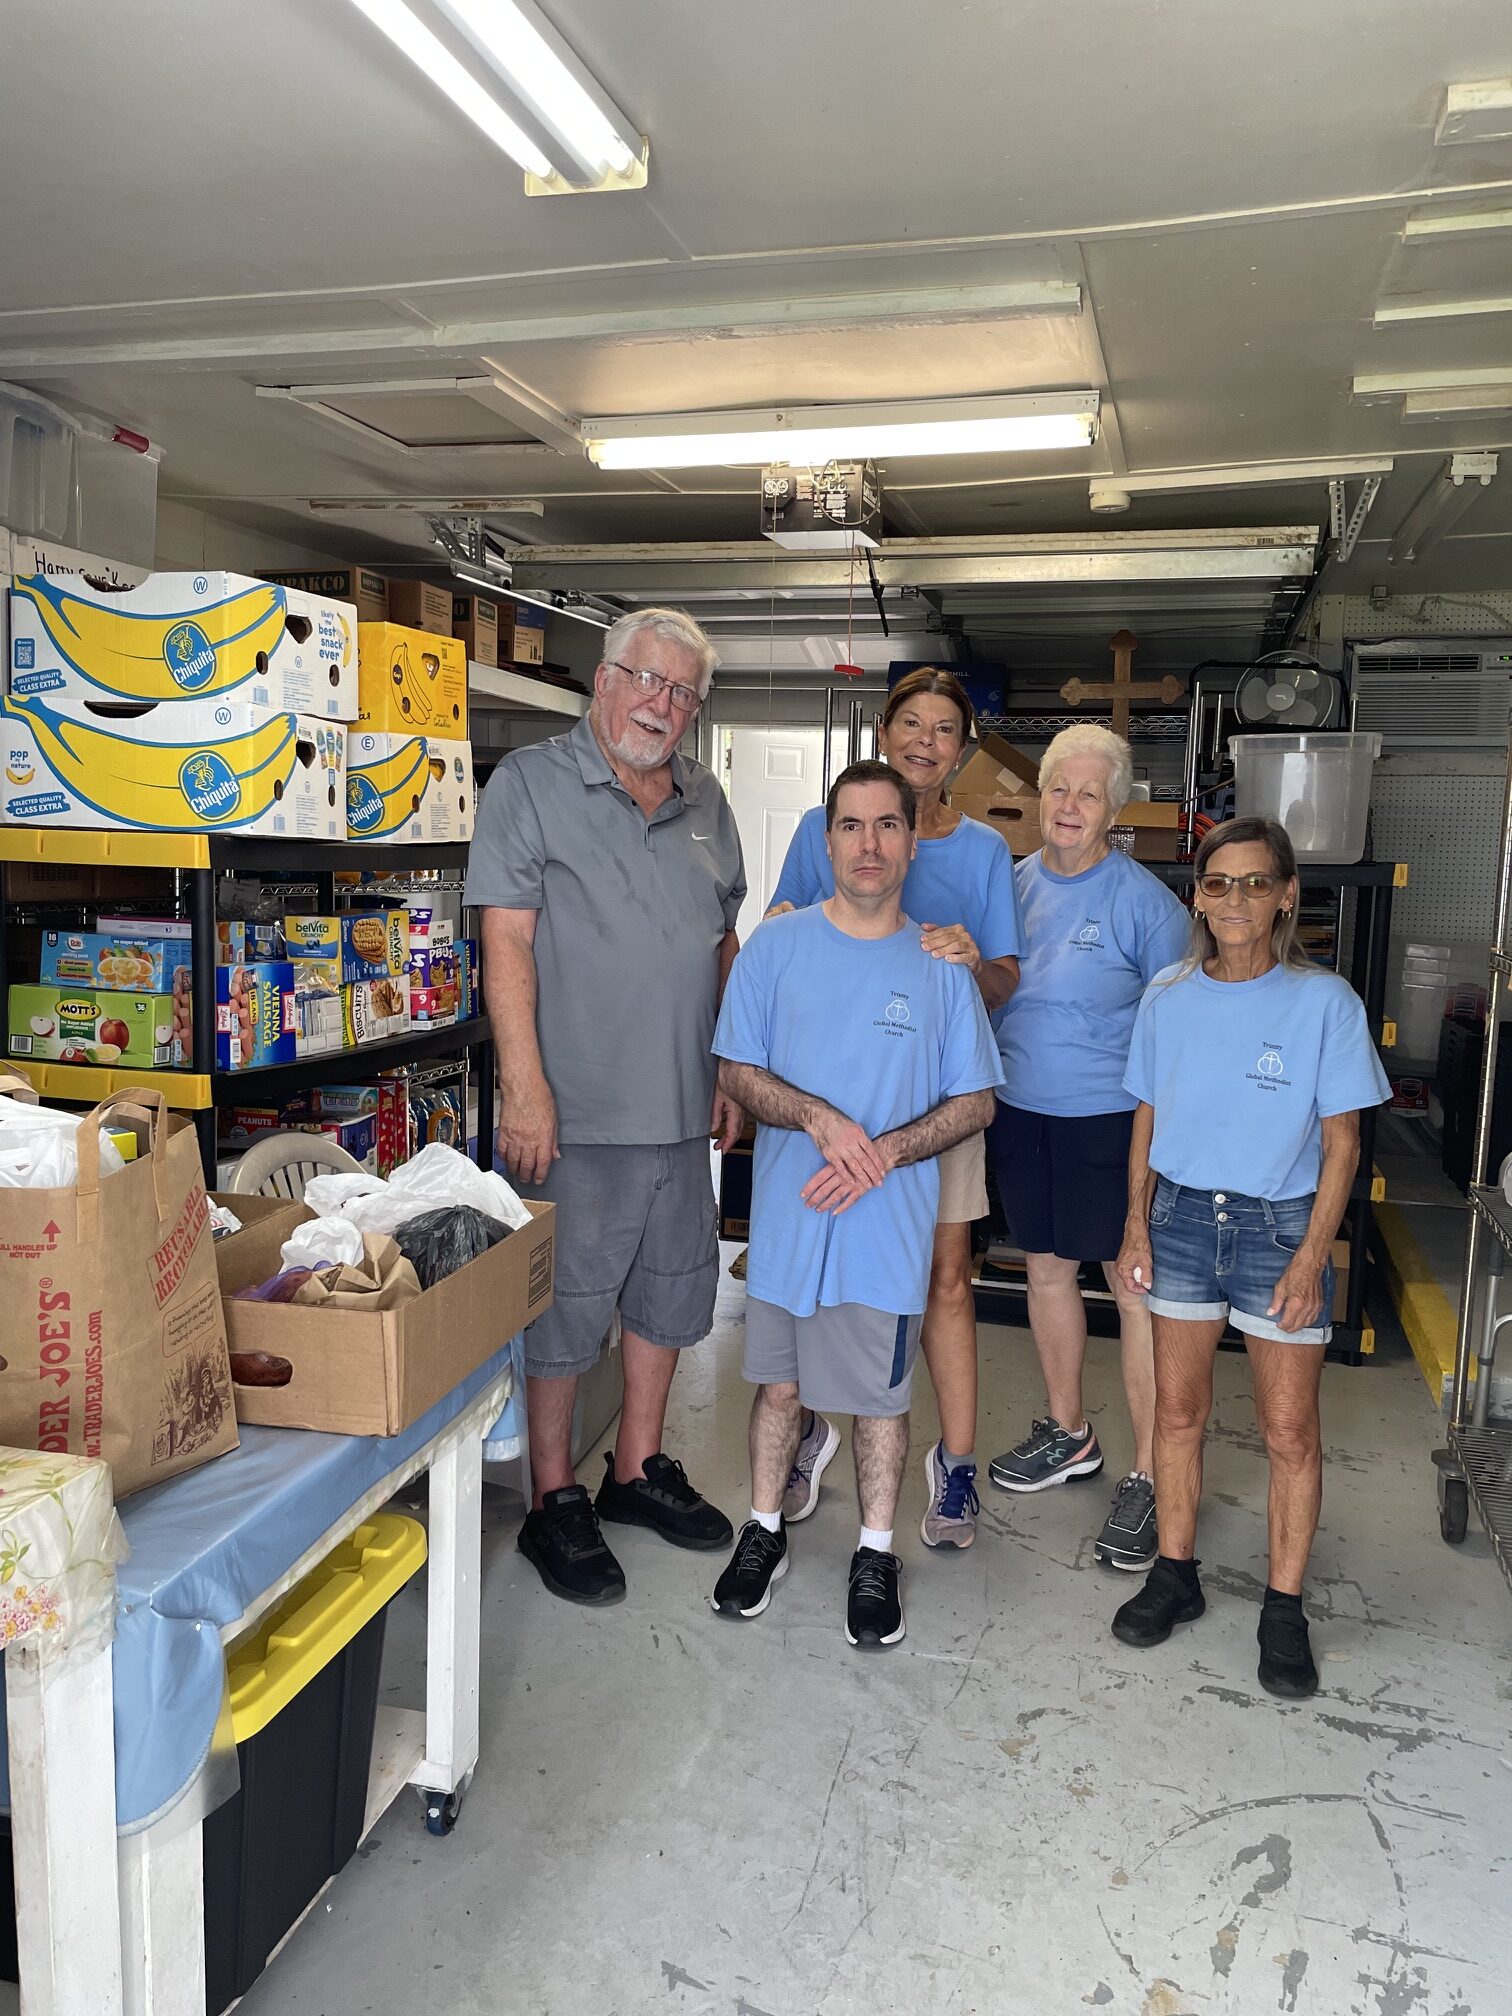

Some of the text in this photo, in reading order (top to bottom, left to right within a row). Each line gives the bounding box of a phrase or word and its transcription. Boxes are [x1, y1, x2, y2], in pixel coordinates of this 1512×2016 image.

[320, 610, 334, 620] likely
[318, 623, 337, 637] best
[321, 637, 344, 650] snack
[319, 648, 340, 661] ever
[173, 648, 216, 685] Chiquita
[16, 671, 59, 685] SELECTED QUALITY
[20, 679, 60, 692] CLASS EXTRA
[10, 750, 29, 761] pop
[12, 795, 62, 807] SELECTED QUALITY
[190, 778, 240, 814] Chiquita
[15, 802, 63, 815] CLASS EXTRA
[346, 797, 384, 827] Chiquita
[296, 920, 329, 932] belVita
[393, 917, 403, 970] belVita
[418, 994, 428, 1005] 9
[890, 991, 909, 1000] Trinity
[60, 1004, 97, 1017] MOTT'S
[250, 1001, 258, 1023] CANS
[262, 980, 272, 1048] SAUSAGE
[271, 985, 281, 1043] VIENNA
[355, 984, 365, 1039] BISCUITS
[884, 1029, 904, 1038] Church
[891, 1022, 917, 1033] Methodist
[1262, 1041, 1283, 1051] Trinity
[1245, 1072, 1292, 1086] Global Methodist
[1257, 1082, 1277, 1091] Church
[237, 1116, 272, 1126] PEANUTS
[9, 1251, 23, 1259] NOT
[38, 1394, 70, 1454] DER
